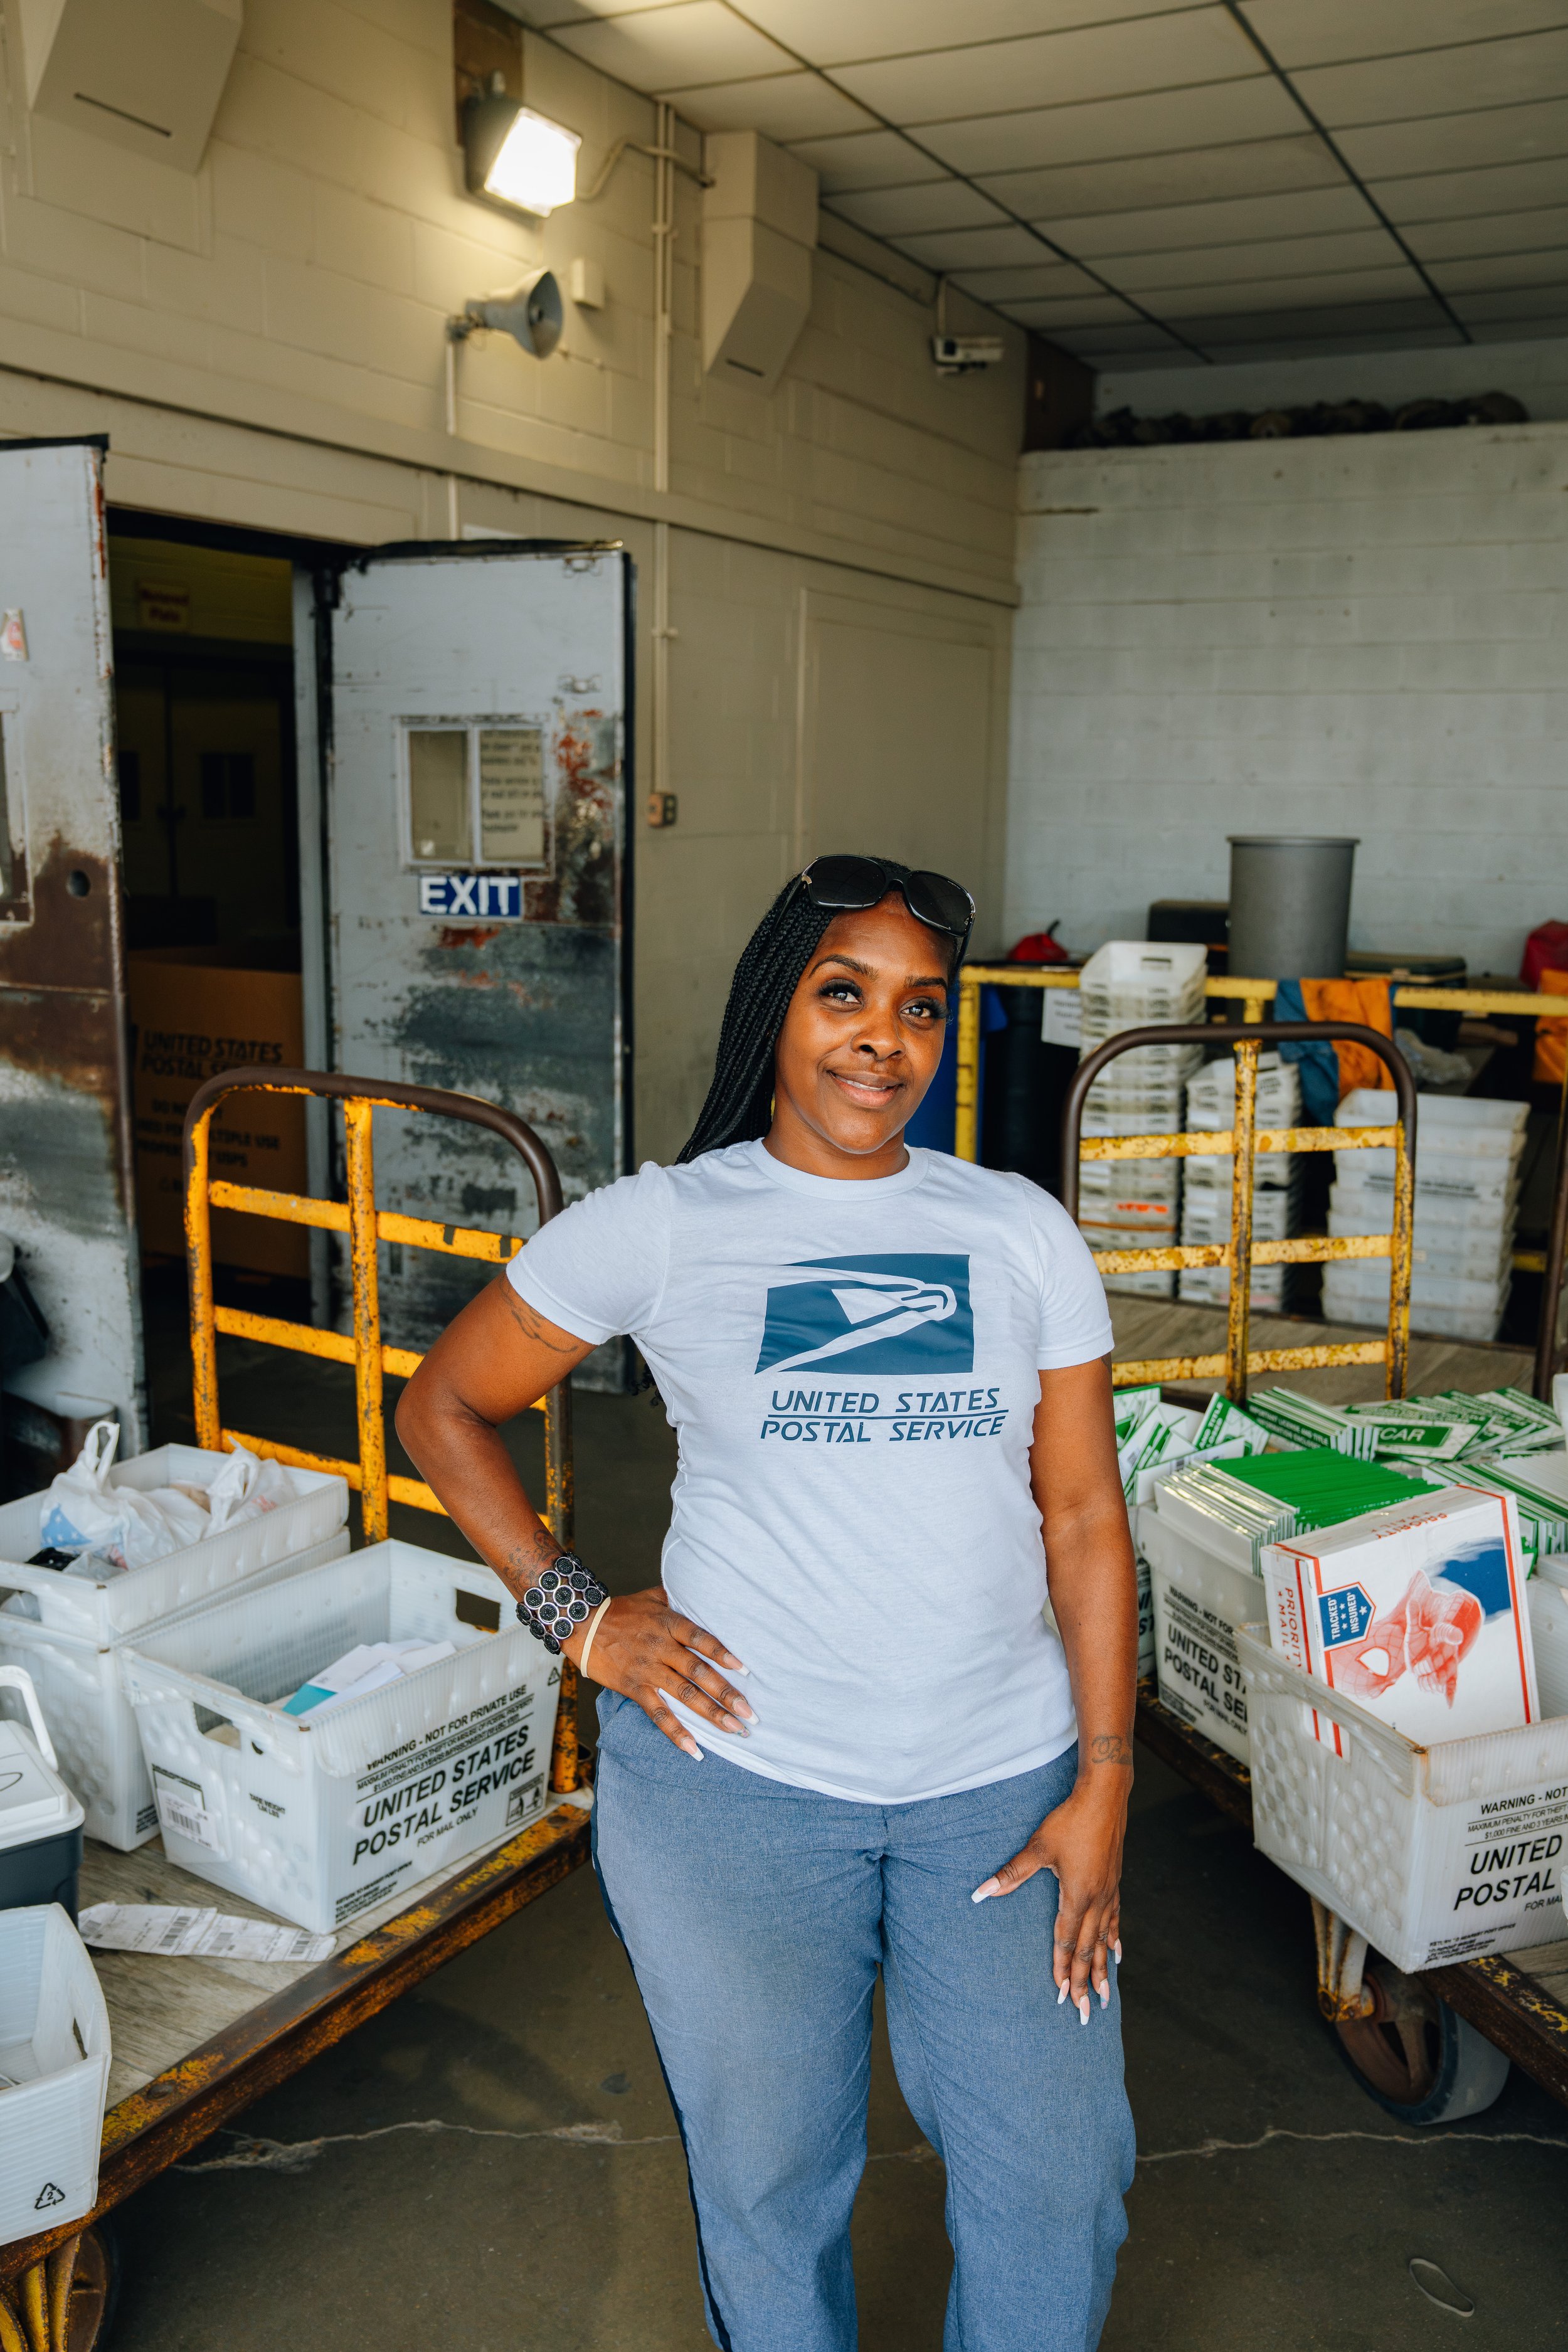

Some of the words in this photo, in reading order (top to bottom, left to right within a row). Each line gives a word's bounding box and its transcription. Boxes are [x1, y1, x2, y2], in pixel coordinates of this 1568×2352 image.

[420, 876, 519, 916] EXIT
[140, 1052, 206, 1080] POSTAL
[144, 1030, 212, 1057] UNITED
[214, 1037, 283, 1064] STATES
[771, 1390, 879, 1413] UNITED
[895, 1387, 1000, 1413] STATES
[760, 1420, 871, 1443] POSTAL
[889, 1415, 1007, 1442] SERVICE
[1199, 1428, 1212, 1449] AND
[1208, 1401, 1224, 1428] TITLE
[1249, 1405, 1278, 1422] IMPORTANT
[1300, 1428, 1313, 1439] AND
[1313, 1432, 1328, 1446] TITLE
[1168, 1584, 1199, 1614] WARNING
[1202, 1608, 1218, 1625] NOT
[1218, 1619, 1234, 1636] FOR
[1278, 1603, 1290, 1647] MAIL
[1328, 1598, 1341, 1640] TRACKED
[1347, 1593, 1360, 1634] INSURED
[1167, 1623, 1219, 1675] UNITED
[1164, 1646, 1219, 1702] POSTAL
[425, 1725, 446, 1743] NOT
[448, 1715, 469, 1732] FOR
[470, 1694, 507, 1722] PRIVATE
[509, 1684, 527, 1701] USE
[364, 1770, 446, 1828] UNITED
[452, 1724, 529, 1783] STATES
[352, 1802, 442, 1866] POSTAL
[449, 1747, 536, 1813] SERVICE
[1468, 1820, 1502, 1833] MAXIMUM
[1502, 1813, 1531, 1826] PENALTY
[1532, 1809, 1546, 1819] FOR
[1547, 1804, 1567, 1815] THEFT
[1481, 1794, 1535, 1815] WARNING
[1545, 1786, 1568, 1801] NOT
[416, 1830, 435, 1847] FOR
[436, 1823, 455, 1838] MAIL
[457, 1806, 479, 1826] ONLY
[1484, 1828, 1505, 1840] $1,000
[1505, 1825, 1522, 1835] FINE
[1522, 1821, 1536, 1831] AND
[1542, 1815, 1563, 1826] YEARS
[1470, 1835, 1562, 1875] UNITED
[1453, 1868, 1555, 1911] POSTAL
[1524, 1899, 1545, 1912] FOR
[1546, 1894, 1562, 1906] MAI
